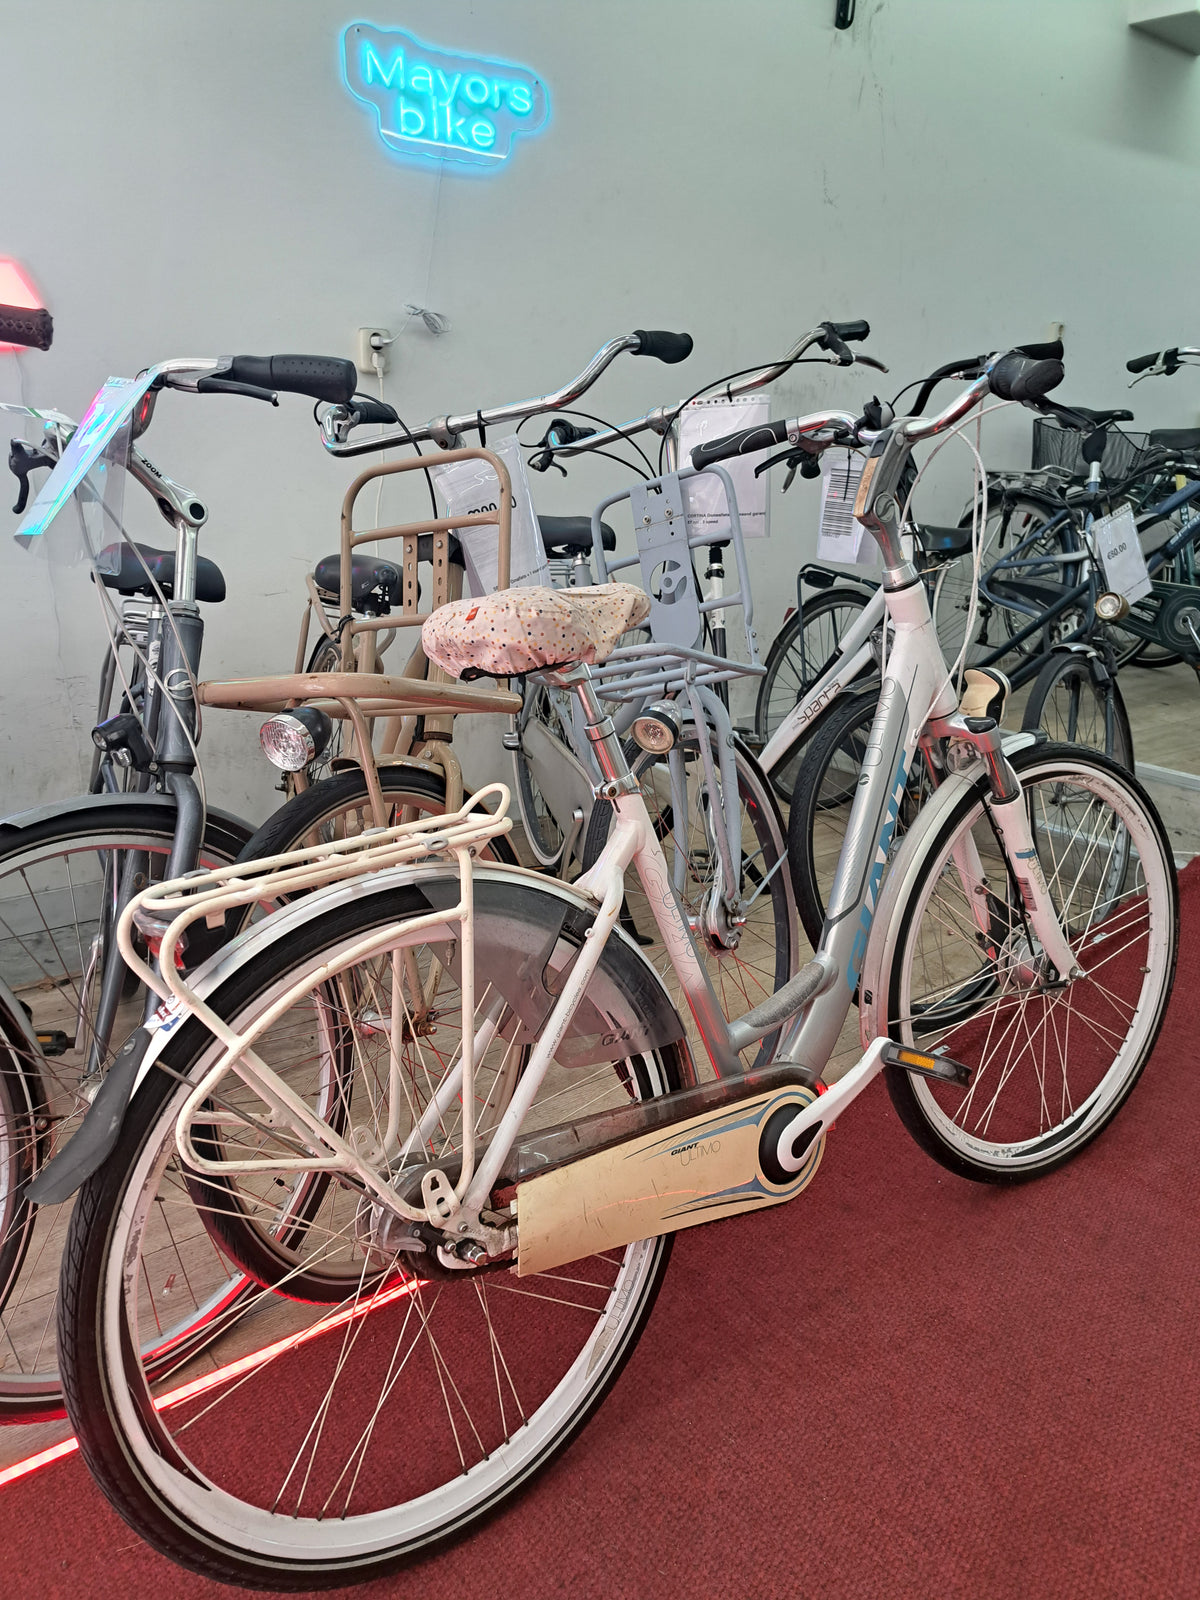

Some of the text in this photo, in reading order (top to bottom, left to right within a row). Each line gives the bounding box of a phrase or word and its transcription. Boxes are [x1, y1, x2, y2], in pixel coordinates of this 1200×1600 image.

[362, 42, 534, 115] Mayors
[399, 96, 496, 148] bike
[141, 458, 162, 479] ZOOM
[797, 682, 841, 725] sparta
[862, 676, 897, 767] ULTIMO
[846, 750, 909, 991] GIANT
[671, 1140, 721, 1167] GIANT ULTIMO
